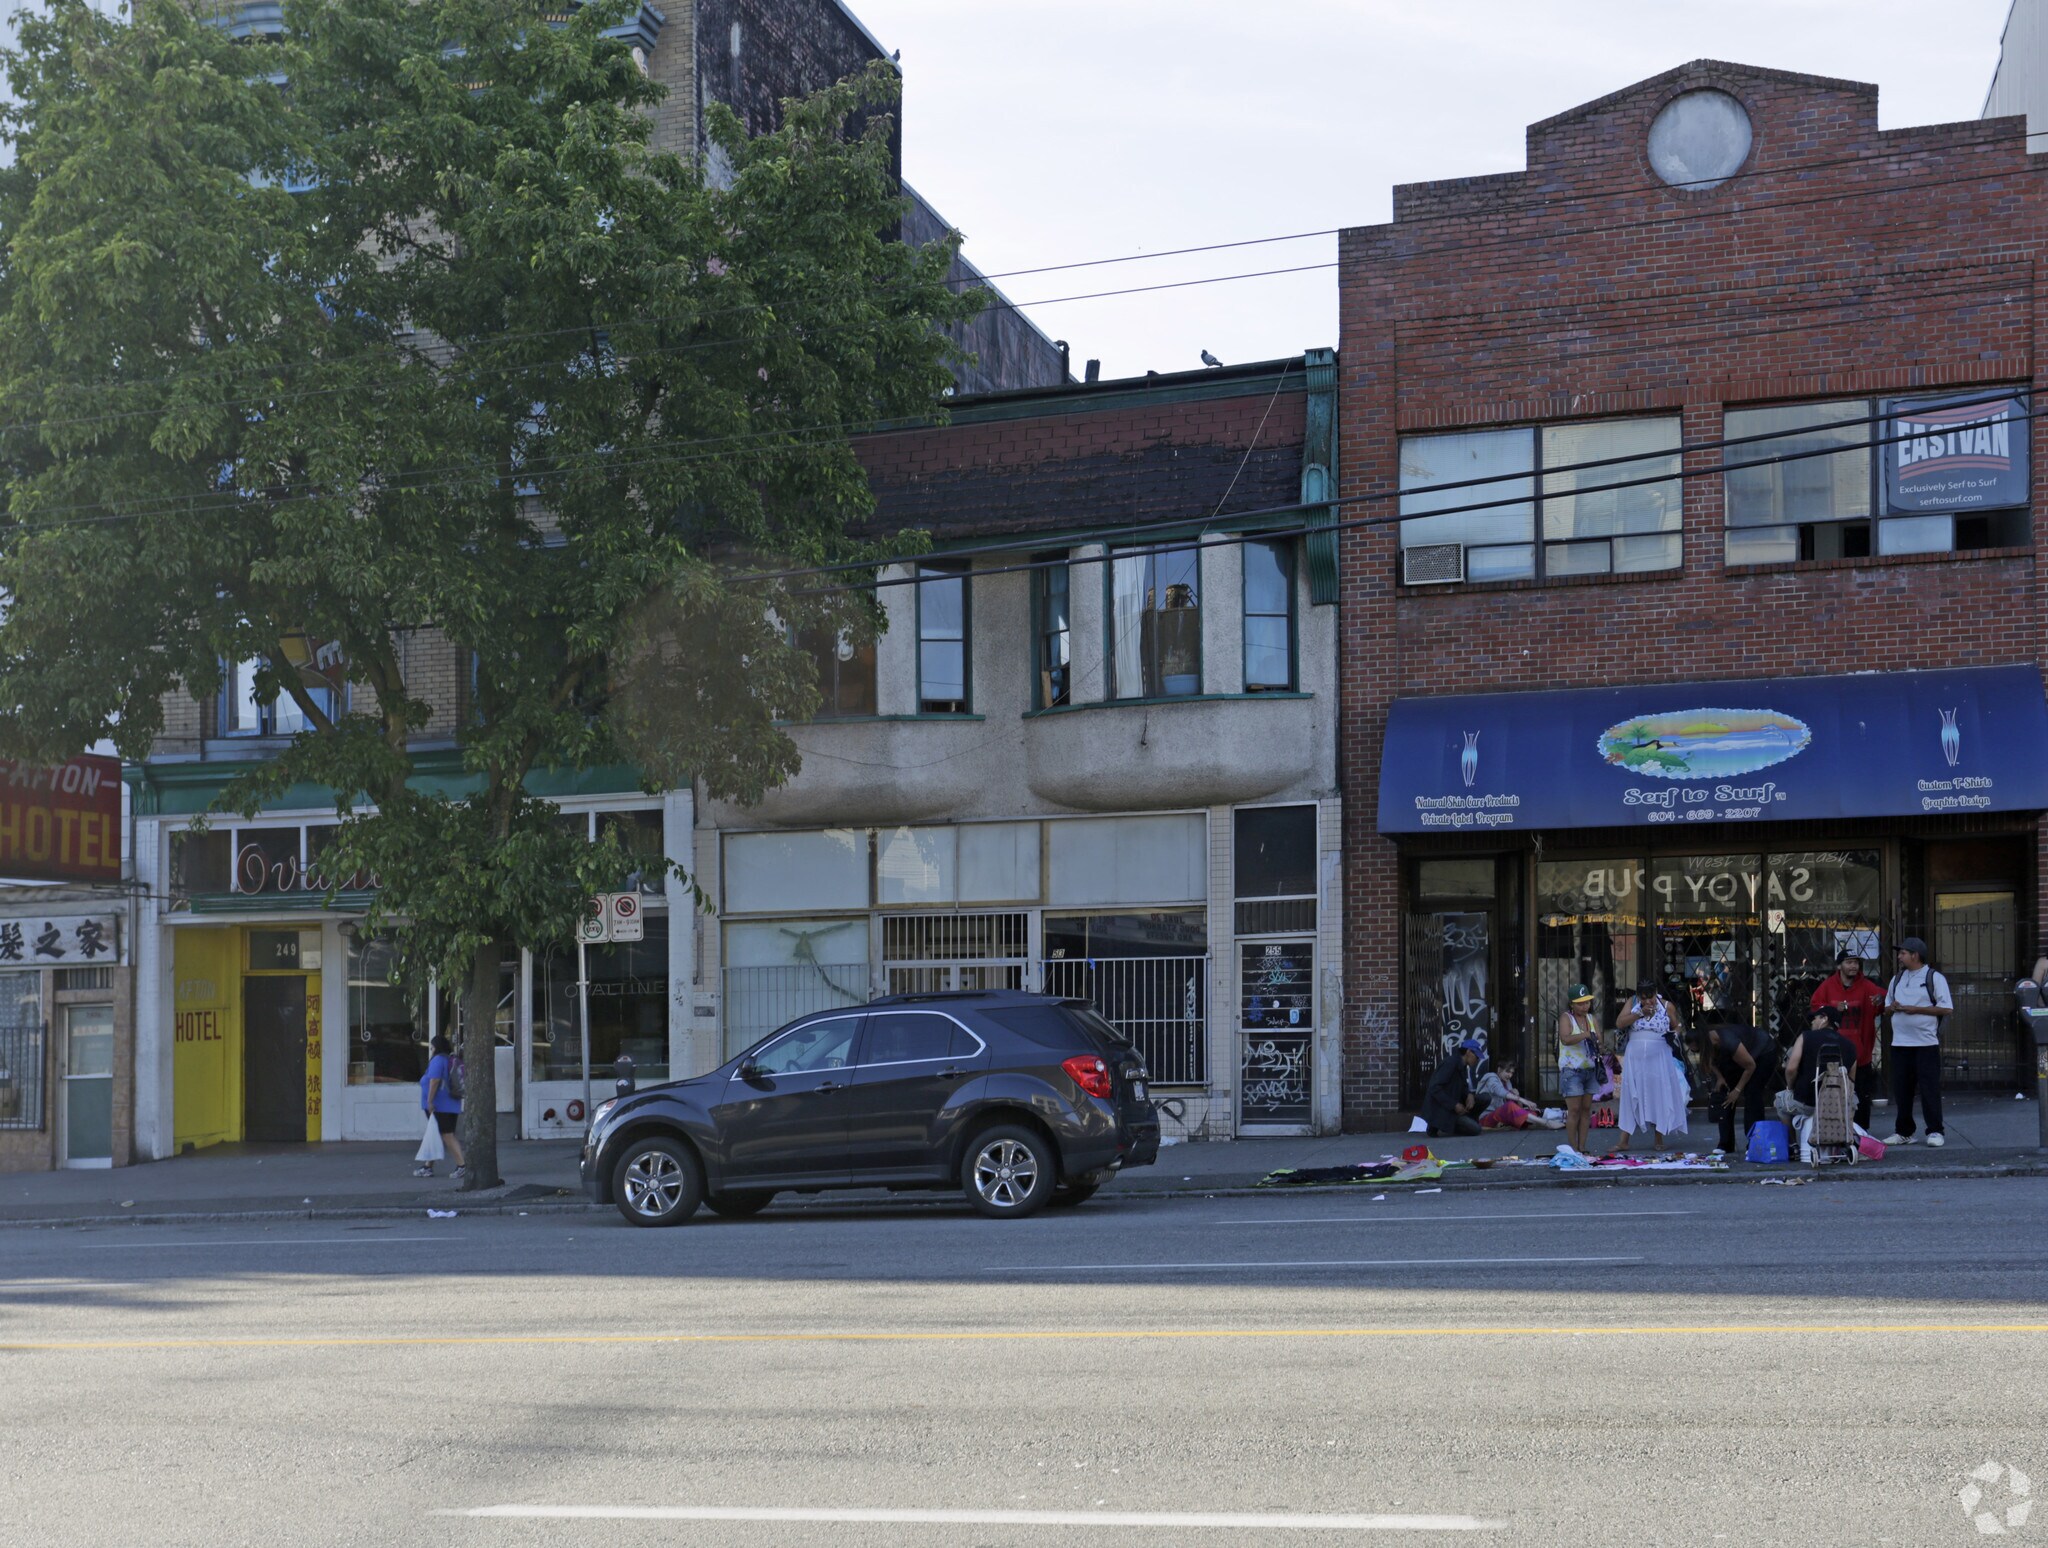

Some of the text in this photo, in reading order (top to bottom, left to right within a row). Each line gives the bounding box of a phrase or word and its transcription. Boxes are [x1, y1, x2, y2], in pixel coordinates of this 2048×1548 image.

[1900, 477, 1997, 494] Exclusively Serf to Surf
[1919, 494, 1983, 506] serftosurf.com
[9, 757, 101, 797] AFTON
[1918, 777, 1992, 791] Custom T-Shirts
[1415, 794, 1520, 809] Natural Skin Care Products
[1623, 787, 1679, 808] Serf
[1682, 788, 1709, 803] to
[1714, 782, 1776, 804] Surf
[1922, 794, 1991, 810] Graphic Design
[1421, 812, 1513, 828] Private Label Program
[0, 804, 119, 868] HOTEL
[1688, 855, 1736, 869] West
[1740, 852, 1793, 867] Cost
[0, 918, 109, 962] 髮之家
[276, 943, 297, 956] 249
[1266, 946, 1281, 955] 255
[176, 1011, 222, 1042] HOTEL
